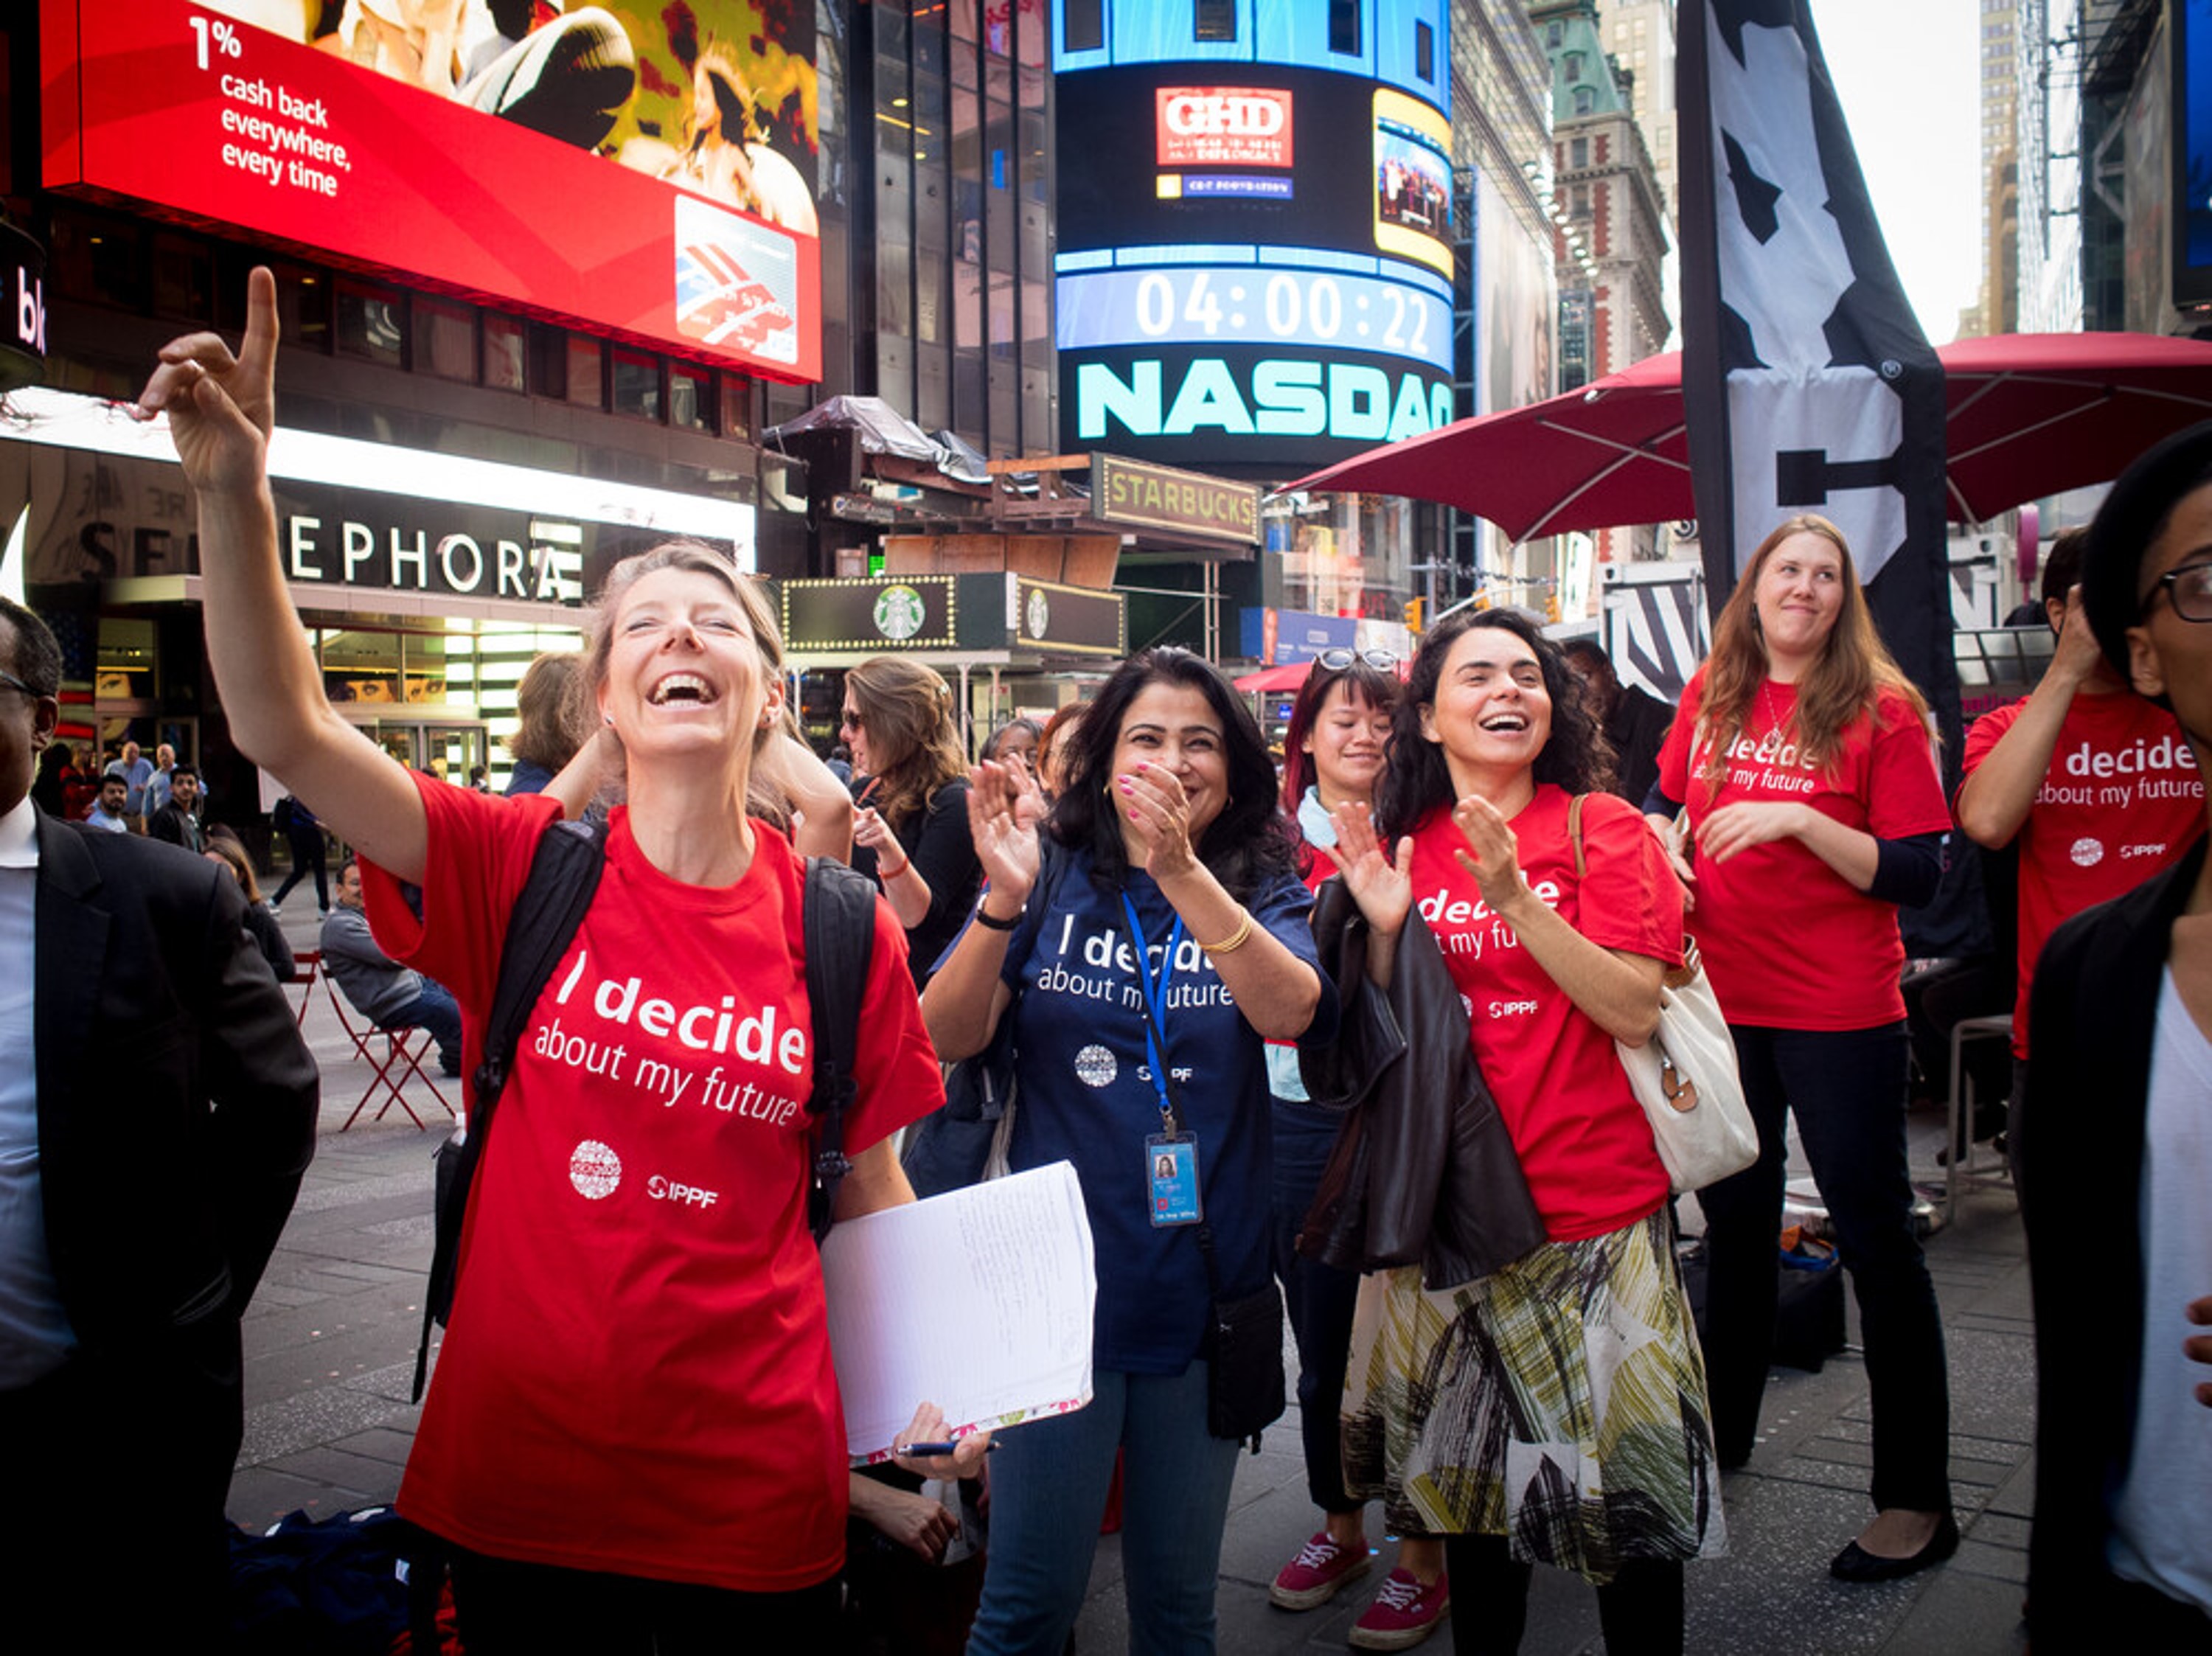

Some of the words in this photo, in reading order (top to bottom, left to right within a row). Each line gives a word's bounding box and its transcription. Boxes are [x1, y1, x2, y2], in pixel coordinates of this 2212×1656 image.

[189, 16, 242, 71] 1%
[220, 74, 273, 110] cash
[278, 85, 329, 129] back
[1166, 97, 1284, 136] GHD
[221, 108, 351, 173] everywhere,
[222, 143, 284, 187] every
[288, 160, 338, 198] time
[1112, 471, 1253, 526] STARBUCKS
[291, 515, 565, 600] EPHORA
[1733, 768, 1759, 791] my
[1761, 768, 1815, 793] future
[2066, 735, 2197, 778] decide
[2100, 784, 2132, 810] my
[2138, 776, 2205, 799] future
[1417, 869, 1560, 924] dece
[1058, 914, 1075, 955] I
[1083, 928, 1216, 976] decid
[1450, 930, 1484, 961] my
[557, 950, 587, 1004] I
[594, 977, 806, 1074] decide
[1037, 961, 1115, 1002] about
[1121, 984, 1148, 1020] m
[1166, 981, 1234, 1009] uture
[1503, 1000, 1539, 1015] IPPF
[535, 1017, 626, 1080] about
[635, 1056, 693, 1107] my
[702, 1066, 798, 1127] future
[667, 1181, 720, 1209] IPPF
